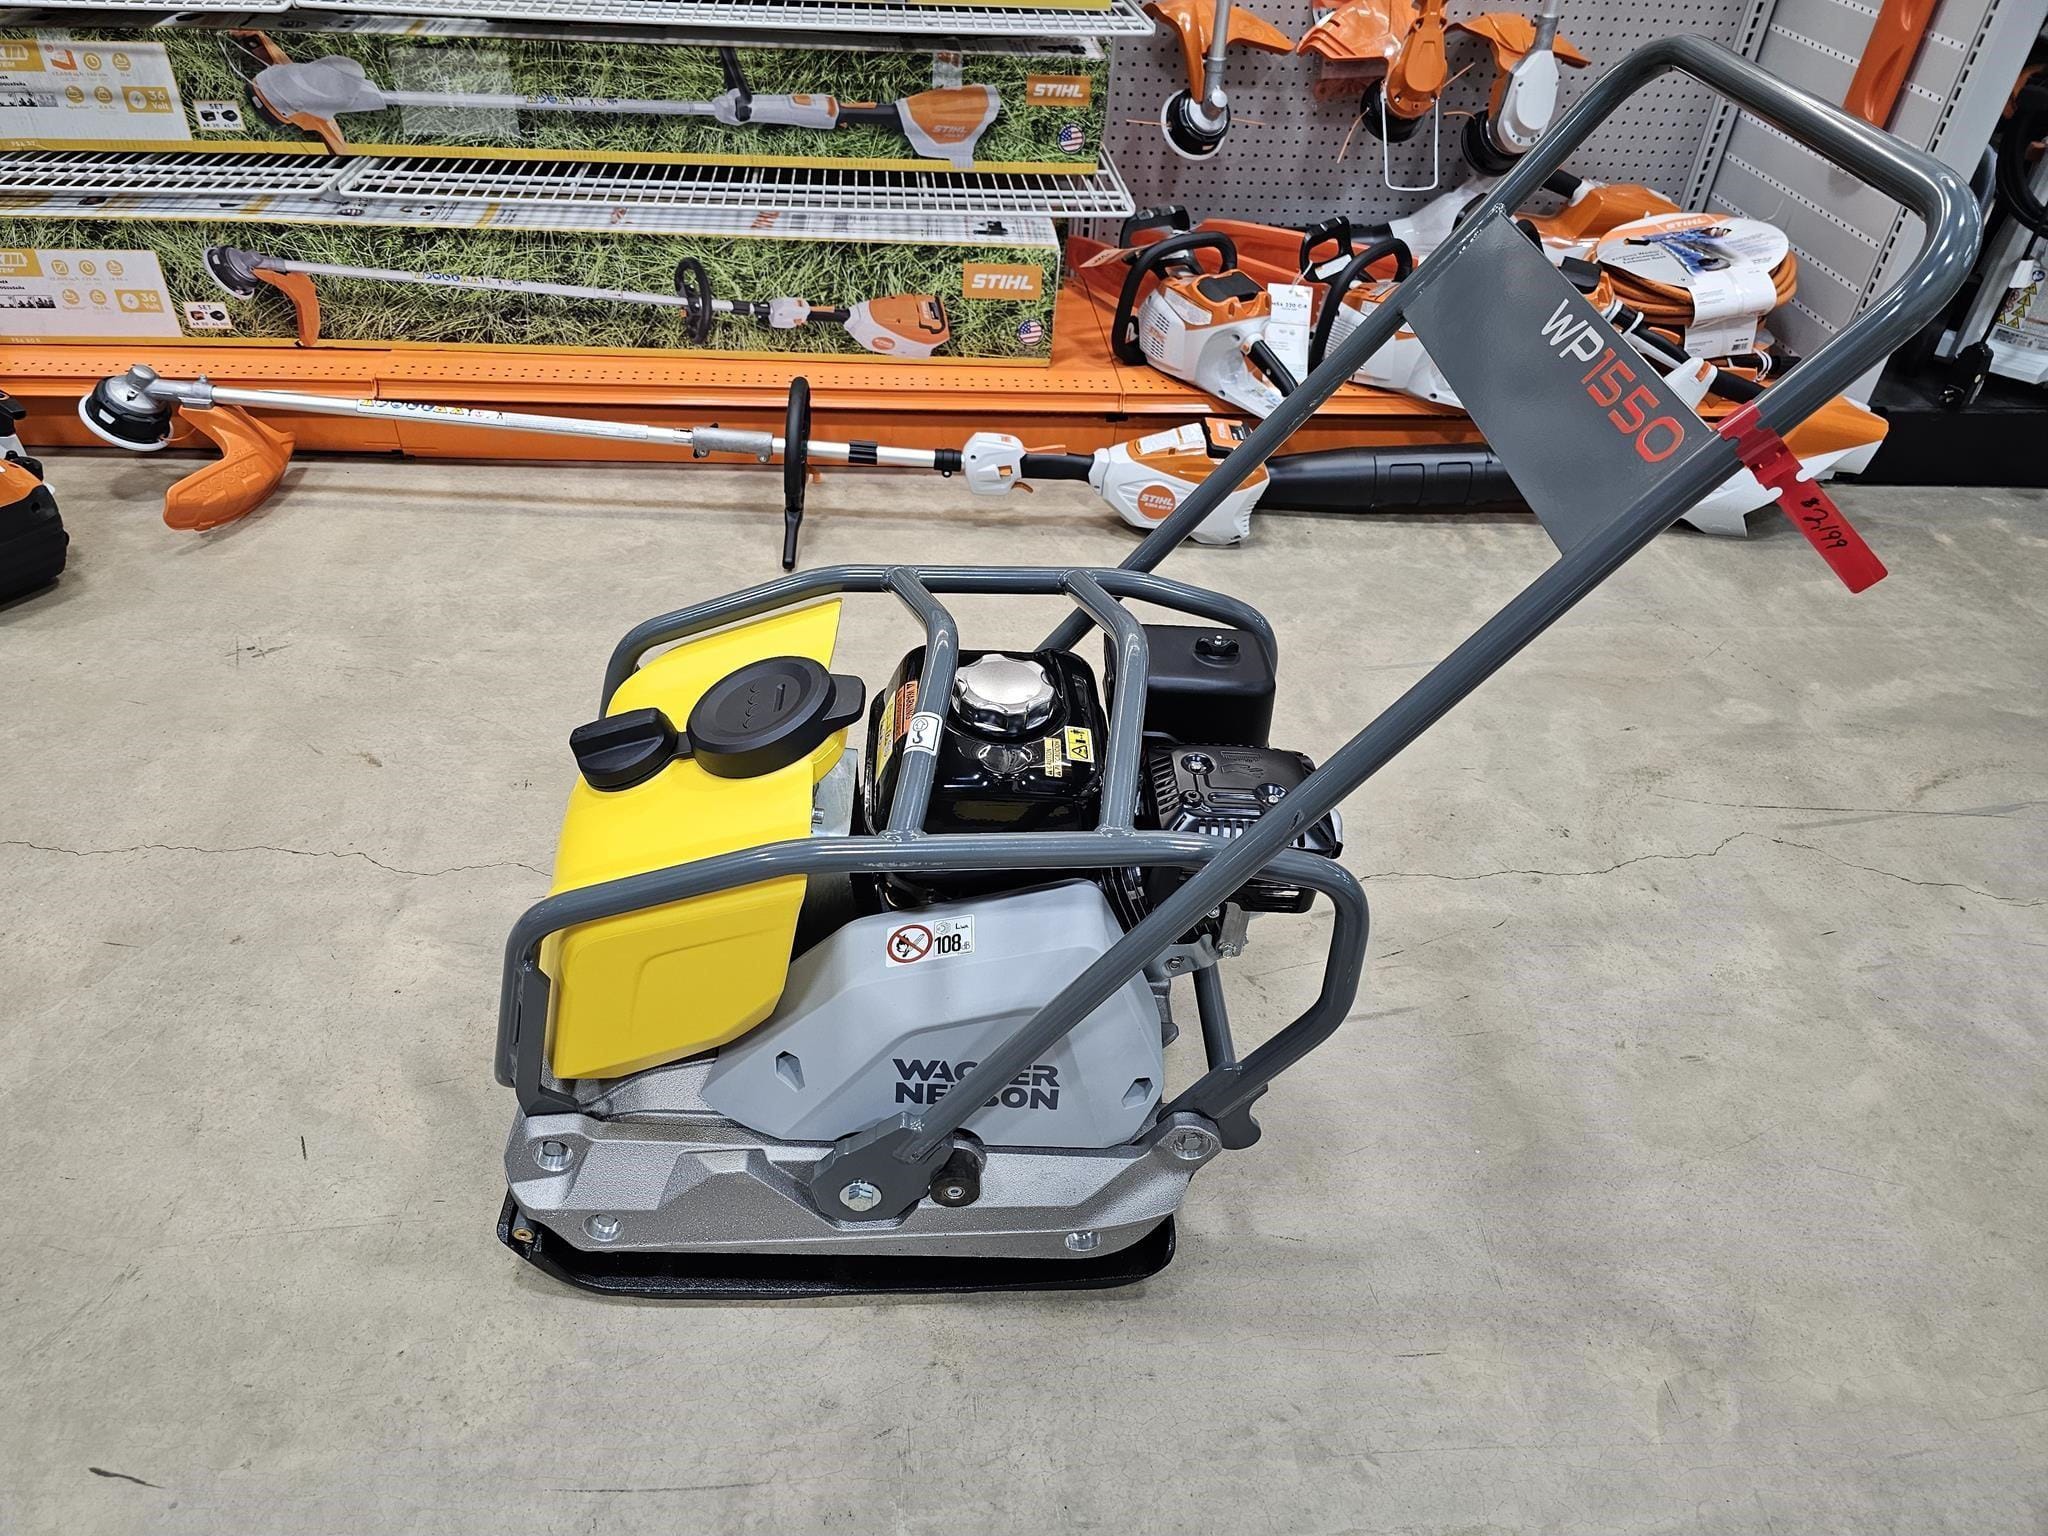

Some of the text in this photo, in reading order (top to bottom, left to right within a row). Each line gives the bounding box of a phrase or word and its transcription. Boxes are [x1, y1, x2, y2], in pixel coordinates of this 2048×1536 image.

[148, 90, 166, 101] 36
[1033, 83, 1084, 98] STIHL
[152, 102, 170, 111] Volt
[1666, 216, 1708, 231] STIHL
[972, 273, 1033, 291] STIHL
[140, 293, 156, 302] 36
[1541, 298, 1685, 463] WP1550
[1140, 493, 1174, 506] STIHL
[905, 691, 916, 720] WARNING
[934, 933, 962, 955] 108
[892, 1058, 1060, 1088] WAGER
[895, 1082, 1060, 1110] NEON
